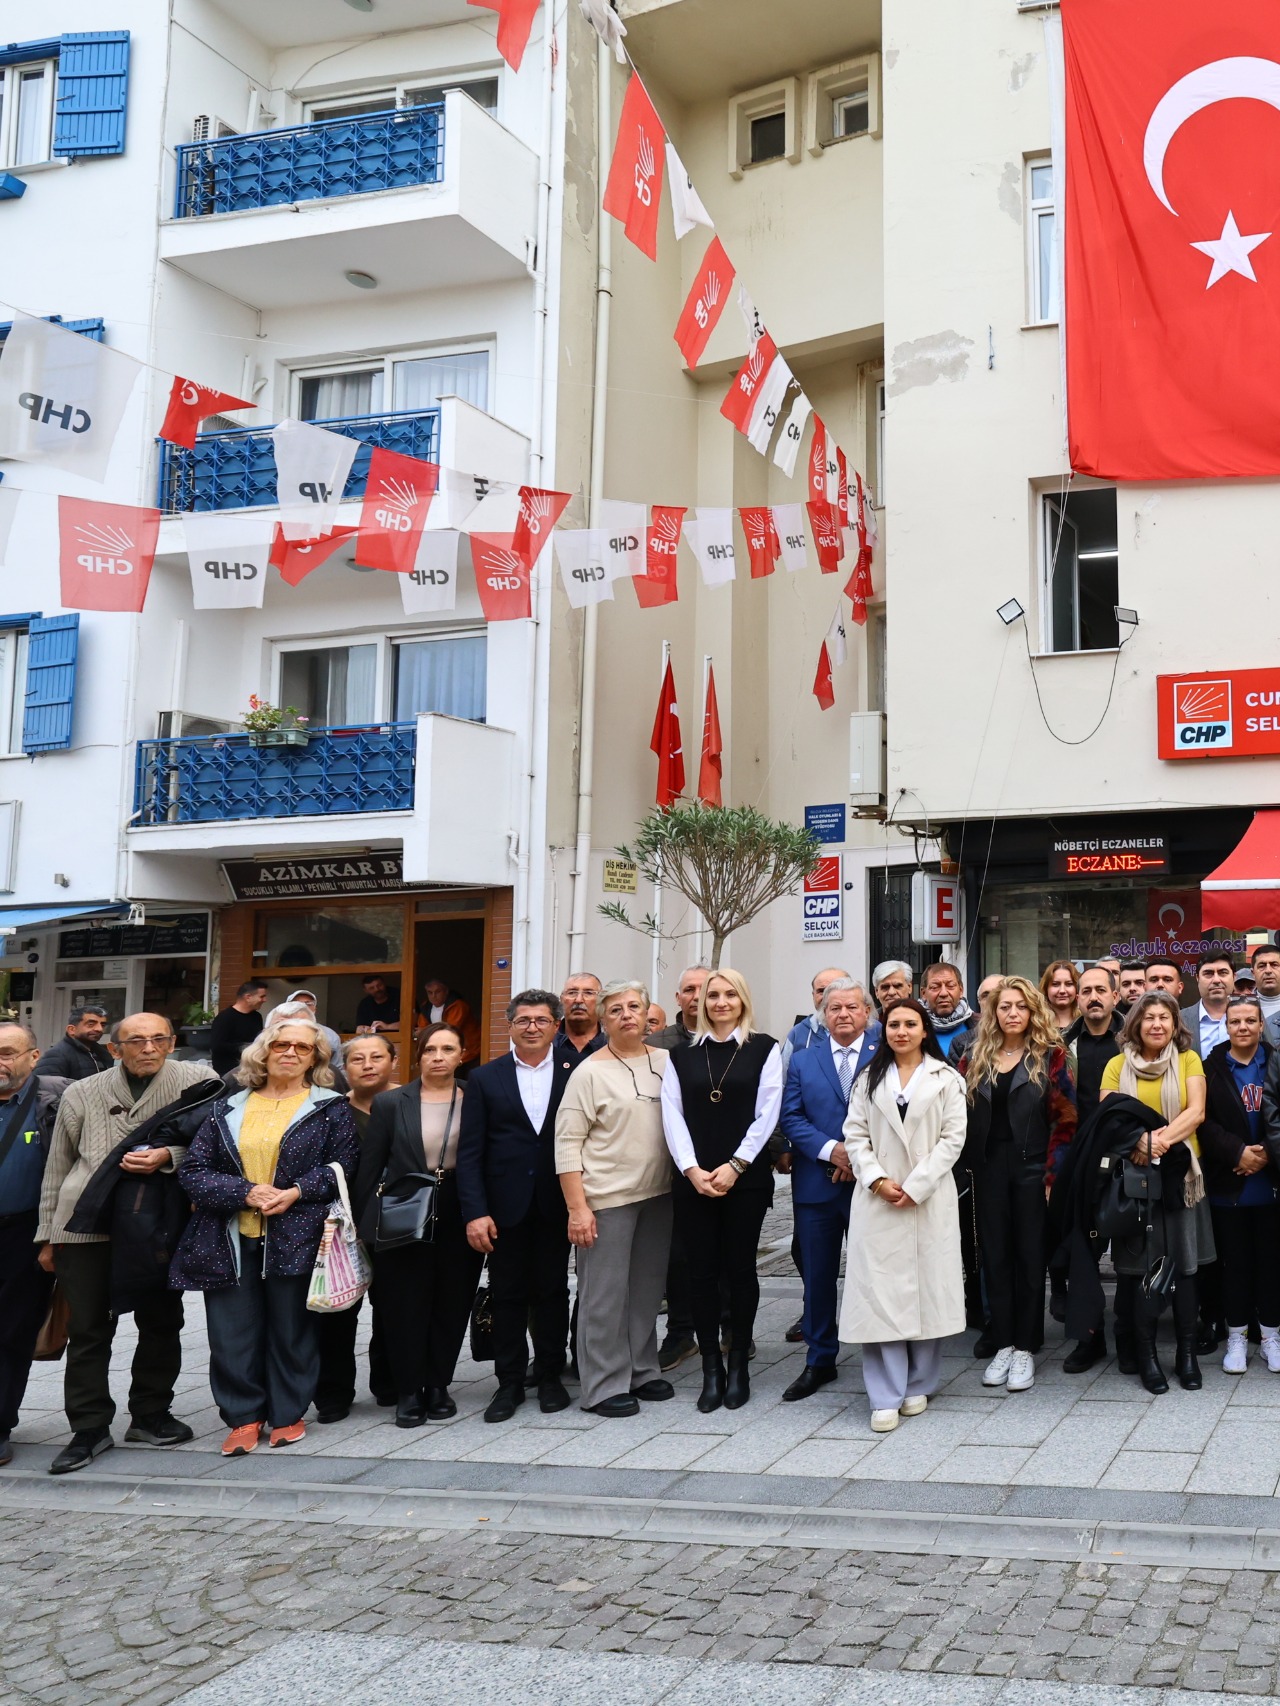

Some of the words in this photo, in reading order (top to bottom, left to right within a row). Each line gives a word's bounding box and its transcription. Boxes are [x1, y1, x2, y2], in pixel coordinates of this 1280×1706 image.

[787, 423, 801, 441] CH
[1180, 725, 1227, 744] CHP
[1054, 838, 1100, 851] NÖBETÇİ
[1101, 838, 1164, 850] ECZANELER
[259, 861, 376, 882] AZİMKAR
[381, 859, 404, 875] B
[805, 898, 839, 915] CHP
[936, 887, 954, 928] E
[804, 921, 839, 931] SELÇUK
[1109, 937, 1167, 959] selçuk
